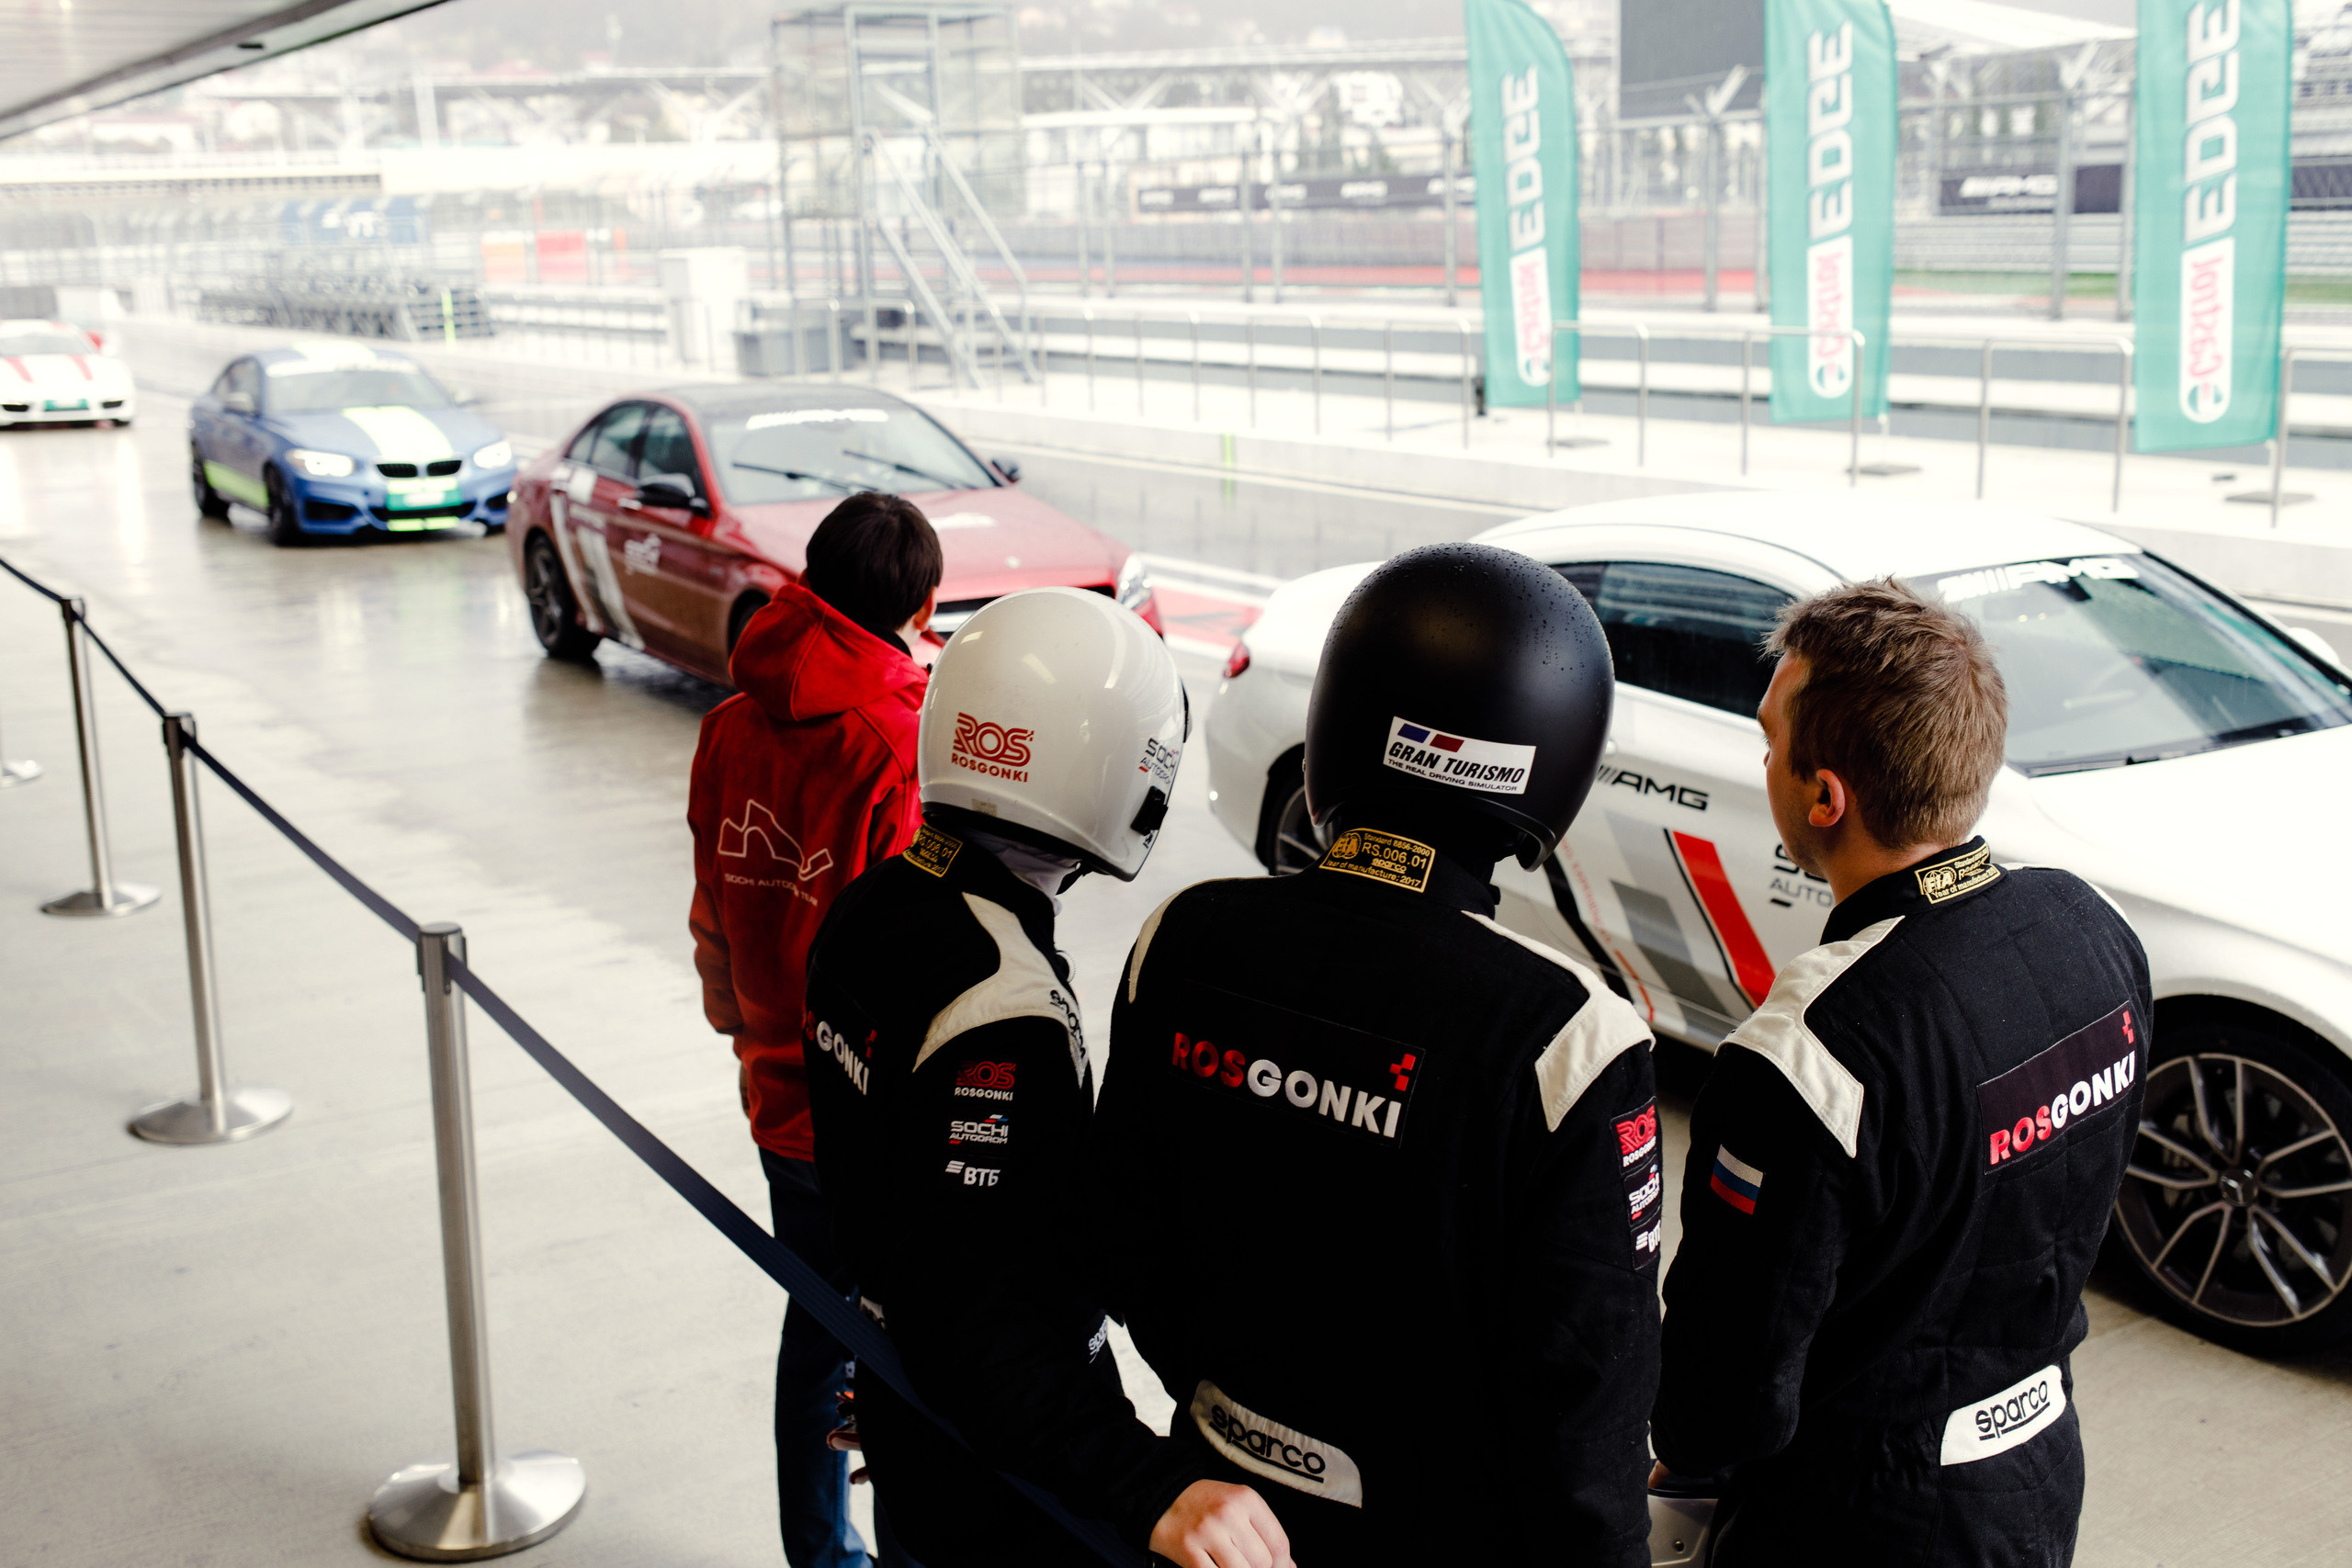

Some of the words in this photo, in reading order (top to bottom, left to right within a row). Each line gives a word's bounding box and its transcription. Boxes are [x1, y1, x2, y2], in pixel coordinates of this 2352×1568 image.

[953, 712, 1035, 767] ROS
[951, 752, 1029, 783] ROSGONKI
[1387, 758, 1404, 769] THE
[1405, 764, 1427, 776] REAL
[1429, 771, 1465, 785] DRIVING
[1467, 780, 1518, 792] SIMULATOR
[1388, 741, 1442, 770] GRAN
[1442, 757, 1526, 784] TURISMO
[1363, 833, 1392, 846] Standard
[1362, 842, 1427, 869] RS.006.01
[1371, 858, 1408, 874] sparco
[1348, 863, 1400, 882] manufacture:
[1399, 875, 1422, 887] 2017
[1931, 888, 1950, 899] Year
[1950, 885, 1958, 893] of
[956, 1060, 1017, 1089] ROS
[1171, 1032, 1402, 1139] ROSGONKI
[954, 1087, 1013, 1101] ROSGONKI
[1989, 1050, 2136, 1165] ROSGONKI
[949, 1133, 1008, 1145] AUTODROM
[950, 1121, 1009, 1137] SOCHI
[1975, 1381, 2050, 1439] sparco
[1210, 1404, 1326, 1479] sparco
